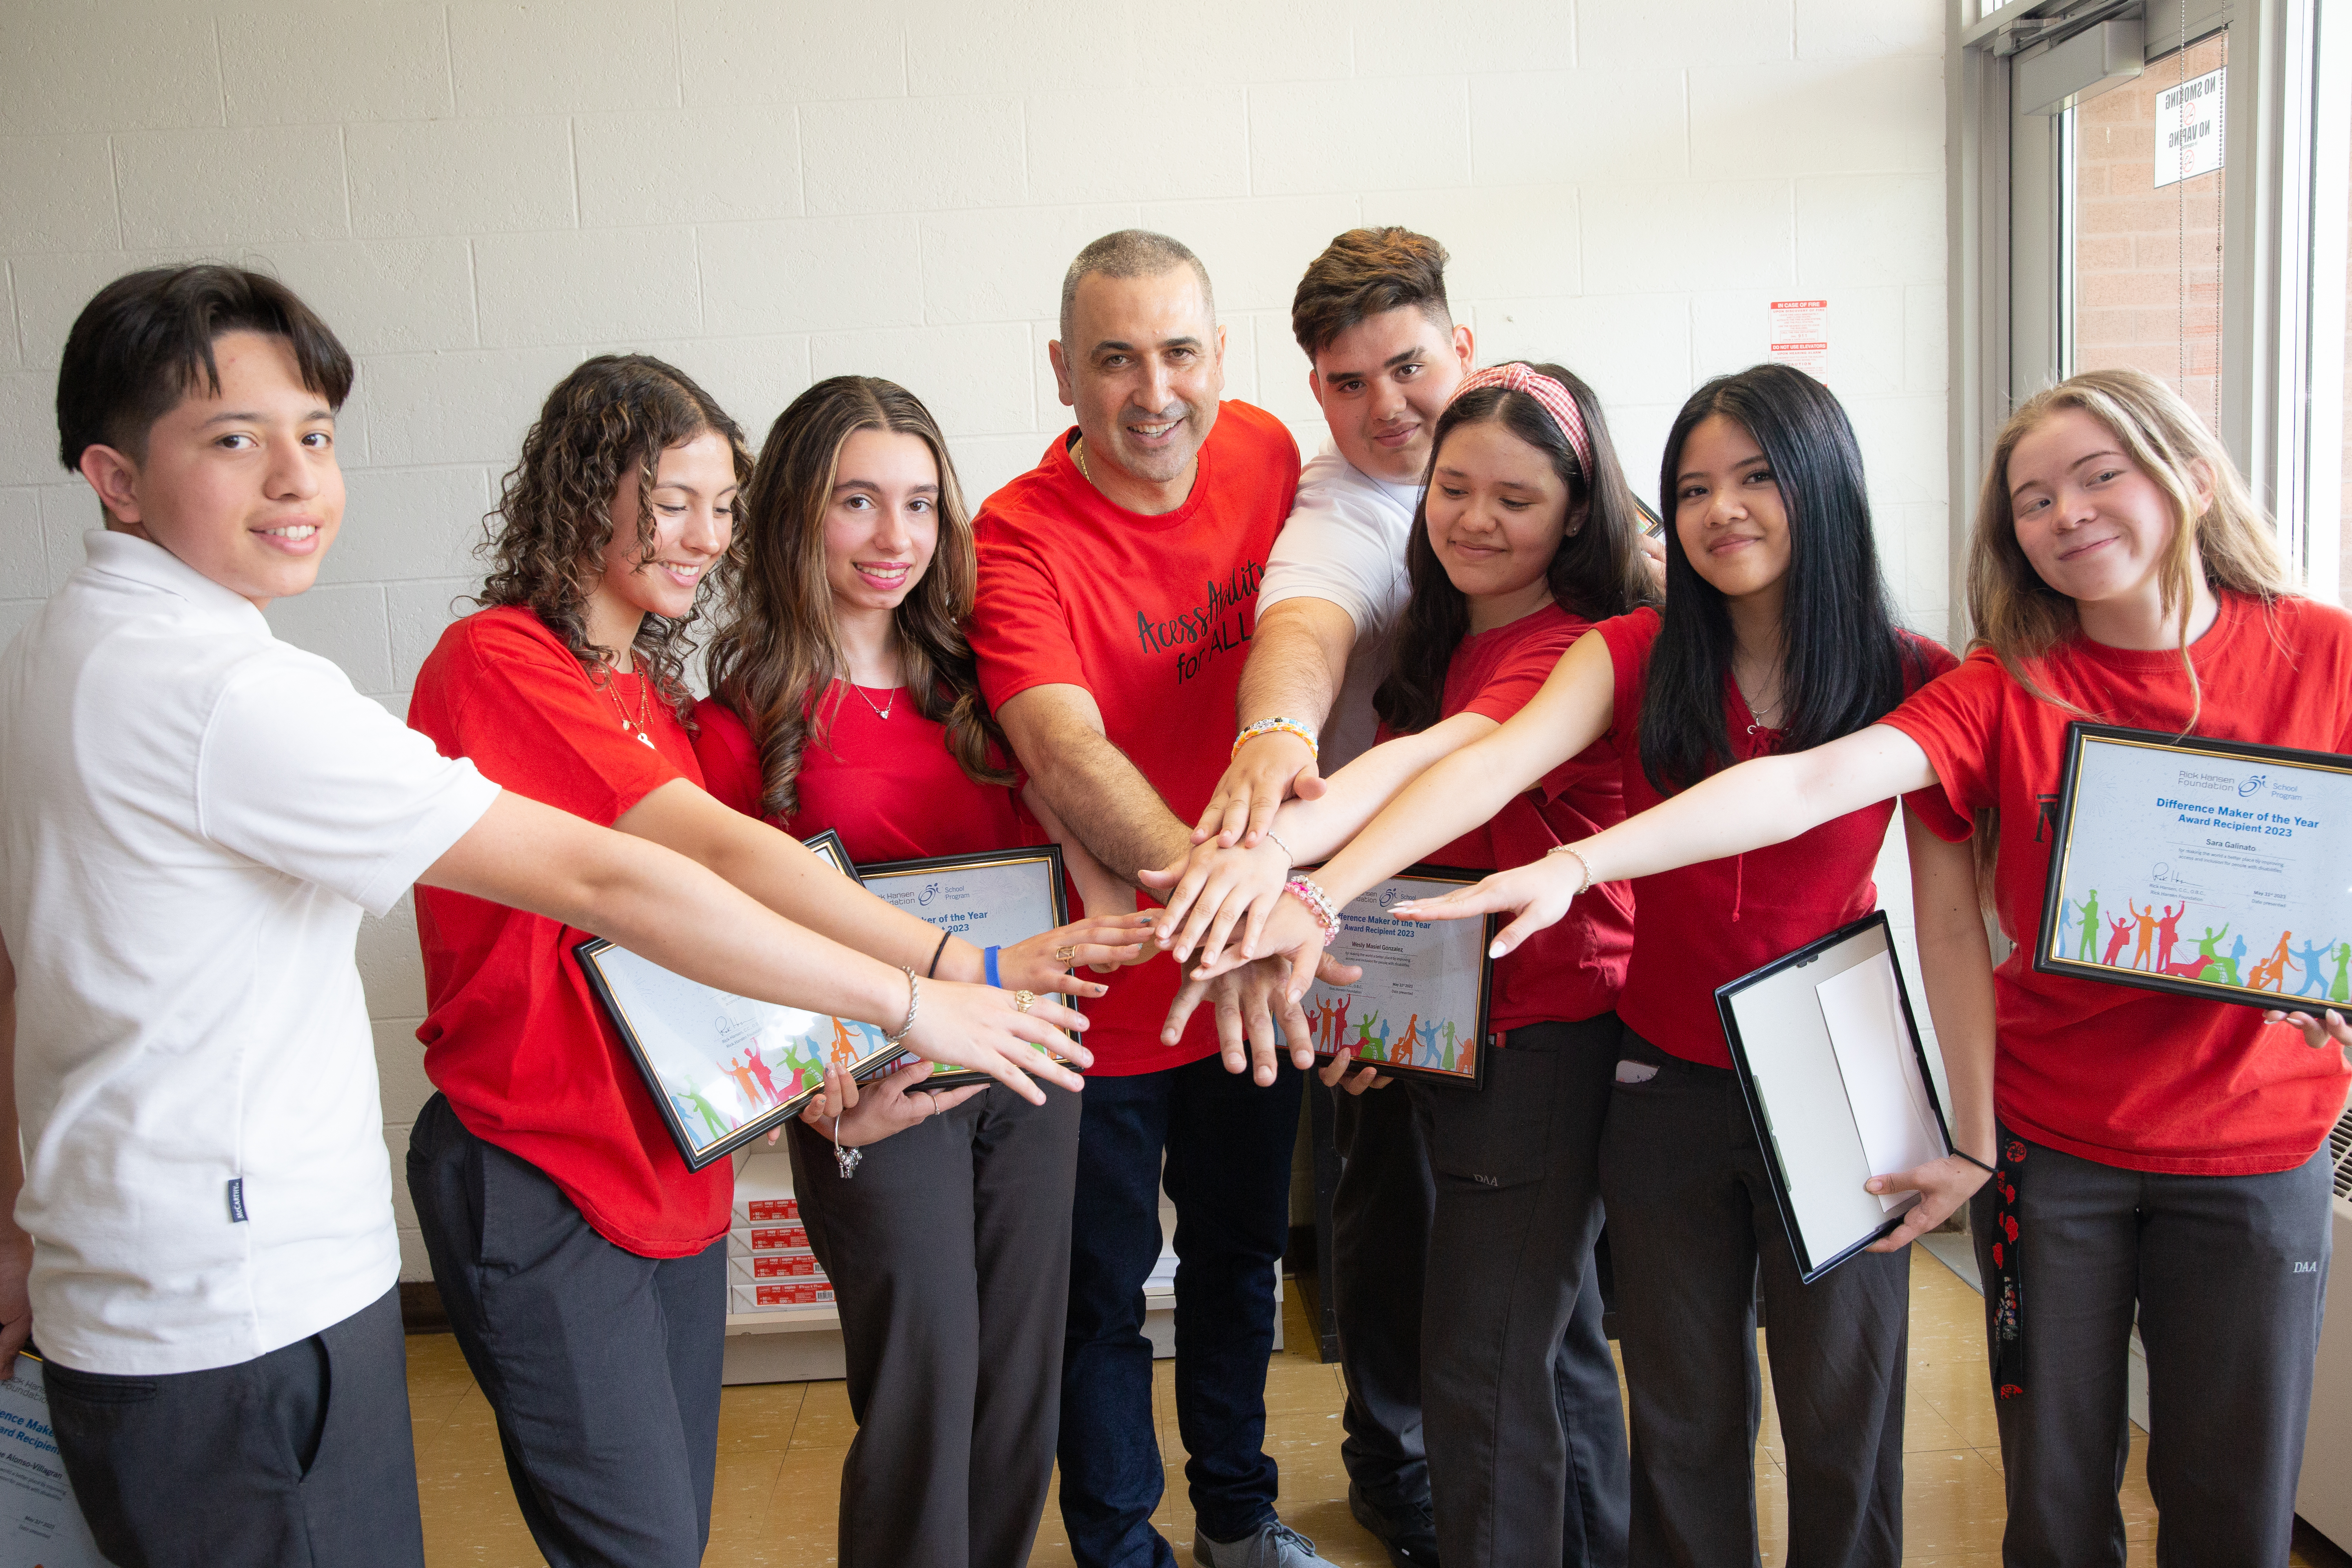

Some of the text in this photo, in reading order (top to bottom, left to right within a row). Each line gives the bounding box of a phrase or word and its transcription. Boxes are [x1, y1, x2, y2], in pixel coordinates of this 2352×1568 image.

[1177, 612, 1253, 684] for ALL
[2179, 771, 2234, 784] Rick Hansen
[2178, 778, 2234, 791] Foundation
[2272, 783, 2299, 792] School
[2271, 791, 2303, 801] Program
[2156, 798, 2319, 829] Difference Maker of the Year
[2178, 814, 2292, 837] Award Recipient 2023
[2206, 839, 2256, 851] Sara Galinato
[939, 914, 948, 923] of
[950, 913, 965, 921] the
[967, 911, 988, 920] Year
[1368, 915, 1390, 925] Maker
[1415, 921, 1431, 929] Year
[948, 924, 969, 933] 2023
[1344, 924, 1414, 937] Award Recipient 2023
[1473, 1174, 1498, 1186] DAA
[2293, 1261, 2317, 1273] DAA
